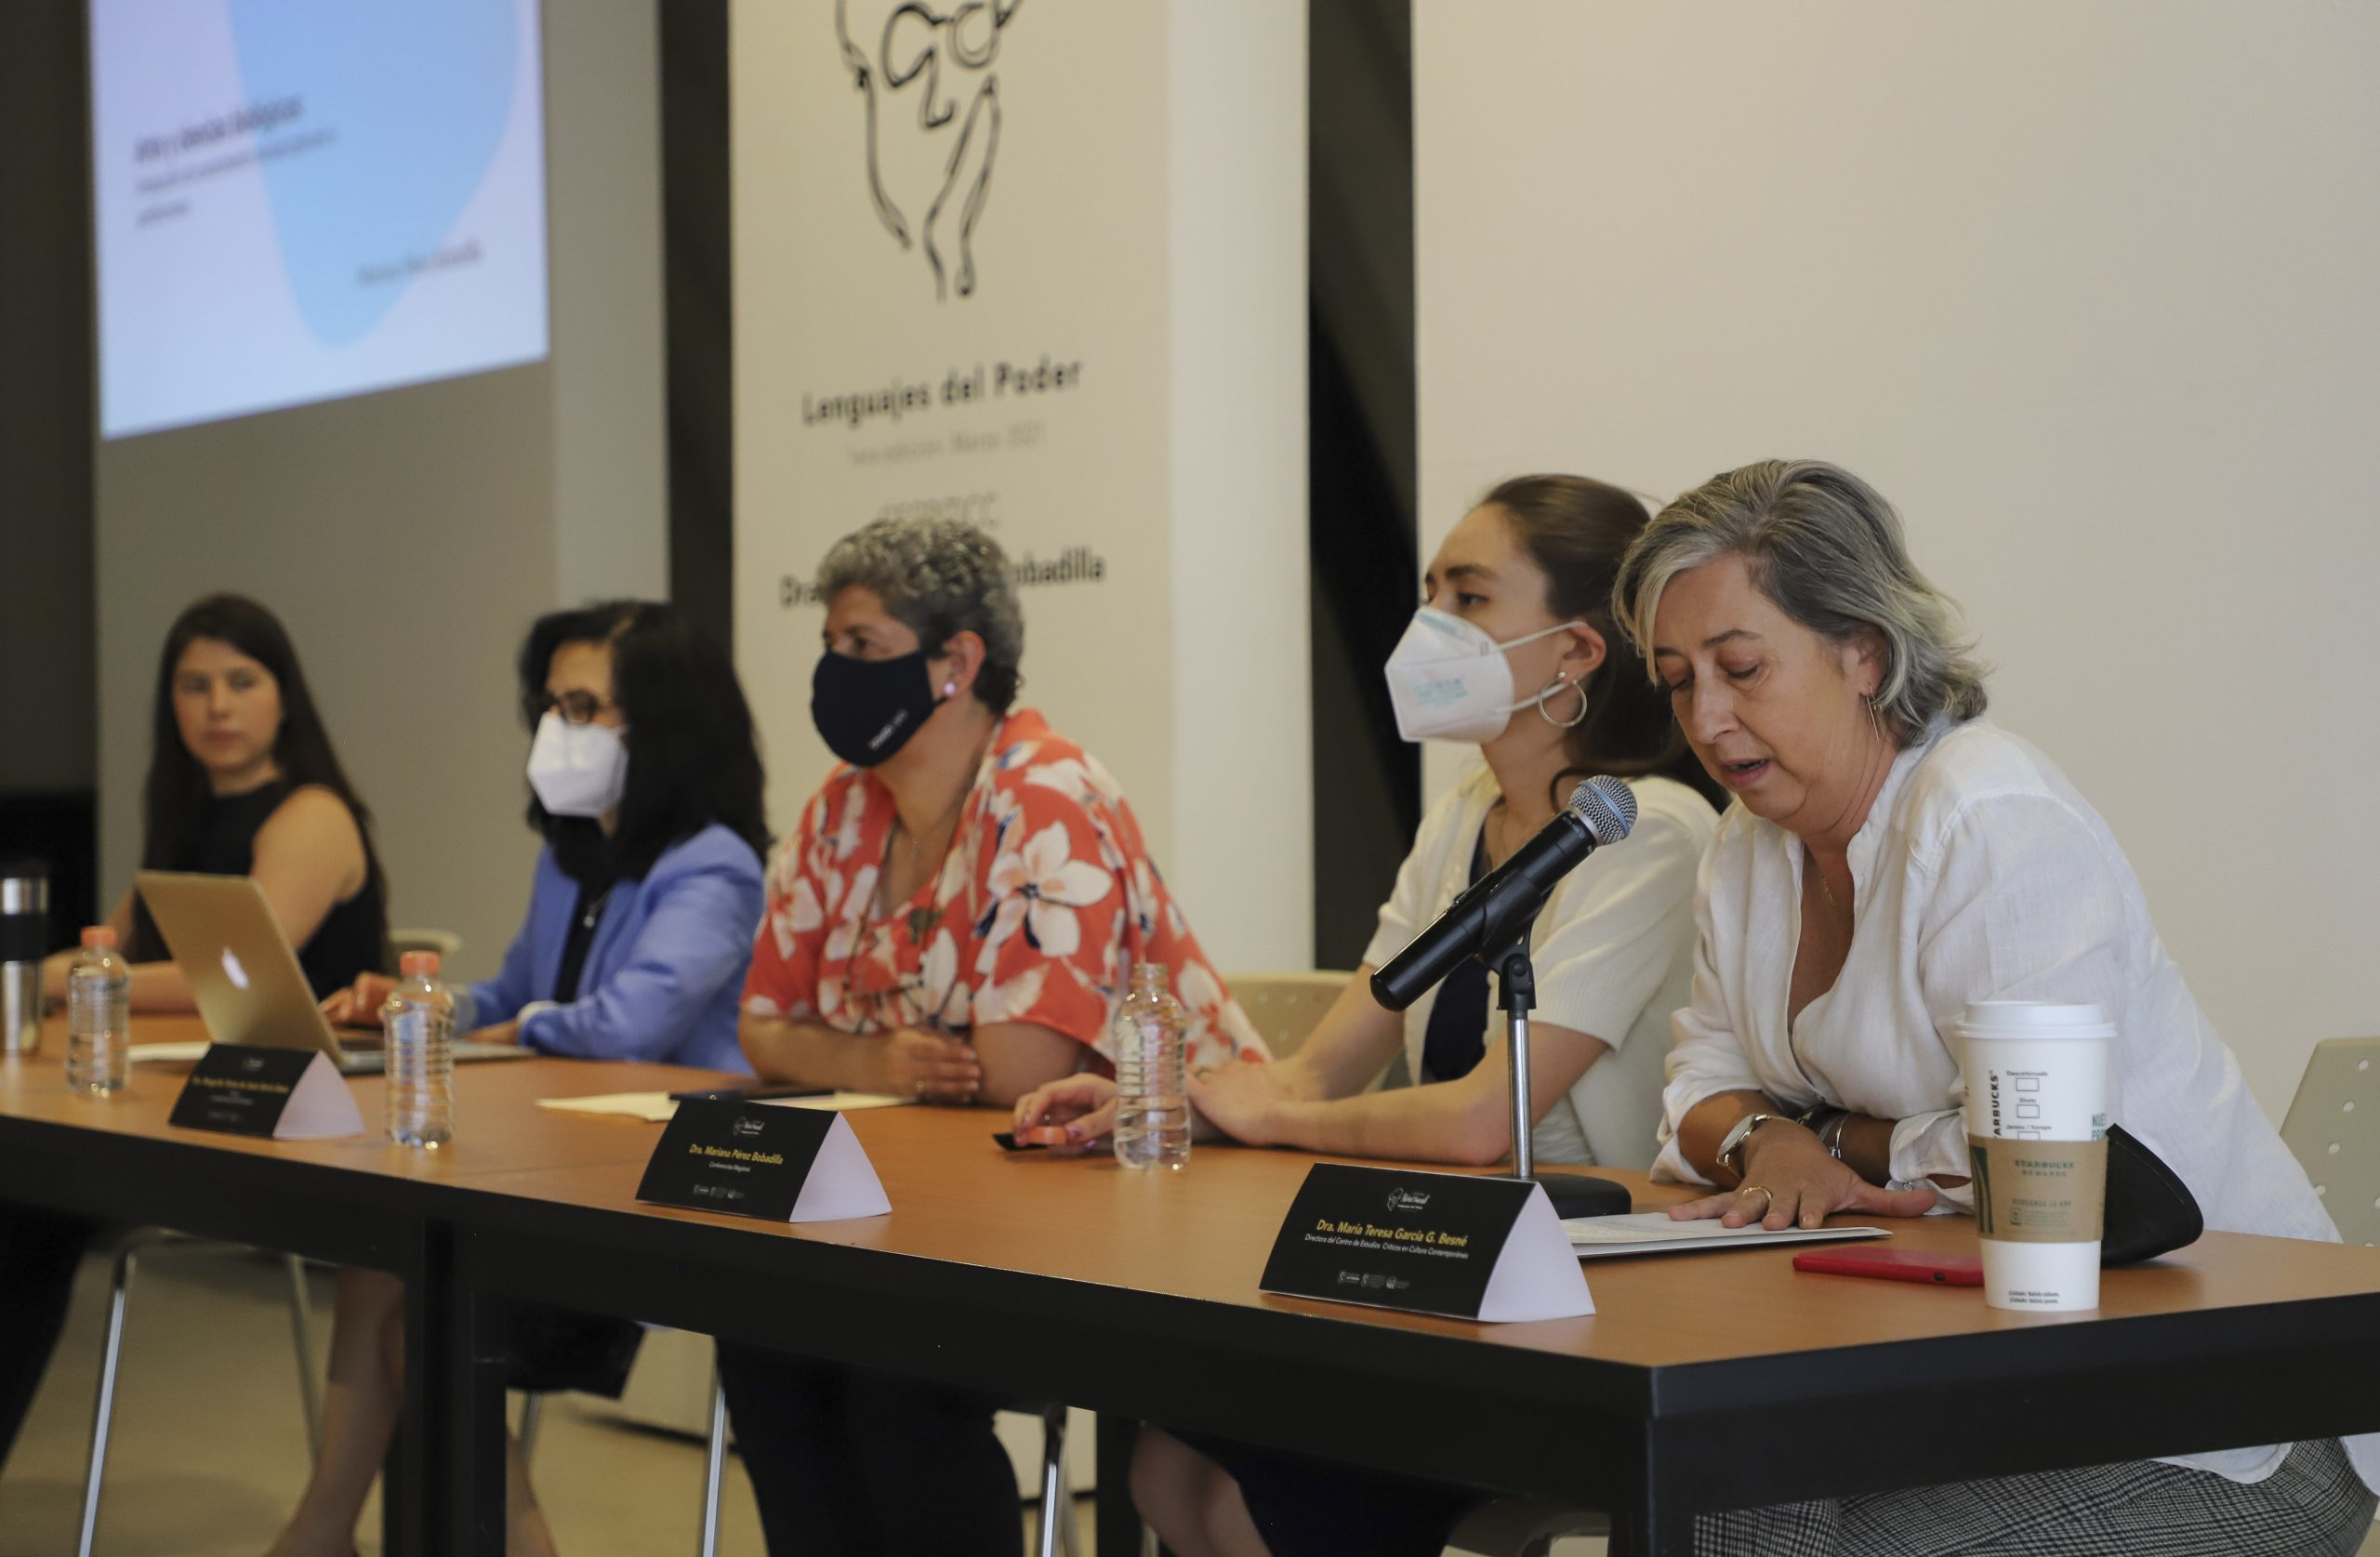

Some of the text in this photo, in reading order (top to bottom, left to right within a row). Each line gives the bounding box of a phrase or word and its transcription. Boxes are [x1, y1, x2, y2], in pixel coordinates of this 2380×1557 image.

[802, 352, 1083, 428] Lenguajes del Poder
[1990, 1075, 2002, 1139] ARBUCKS
[2092, 1114, 2106, 1127] NUE
[751, 1152, 784, 1165] Bobadilla
[2015, 1160, 2074, 1168] STARBUCKS
[1316, 1219, 1468, 1247] Dra. María Teresa García G. Besné
[1304, 1234, 1327, 1243] Directora
[1336, 1237, 1353, 1246] Centro
[1360, 1240, 1381, 1249] Estudios
[1409, 1246, 1427, 1254] Cultura
